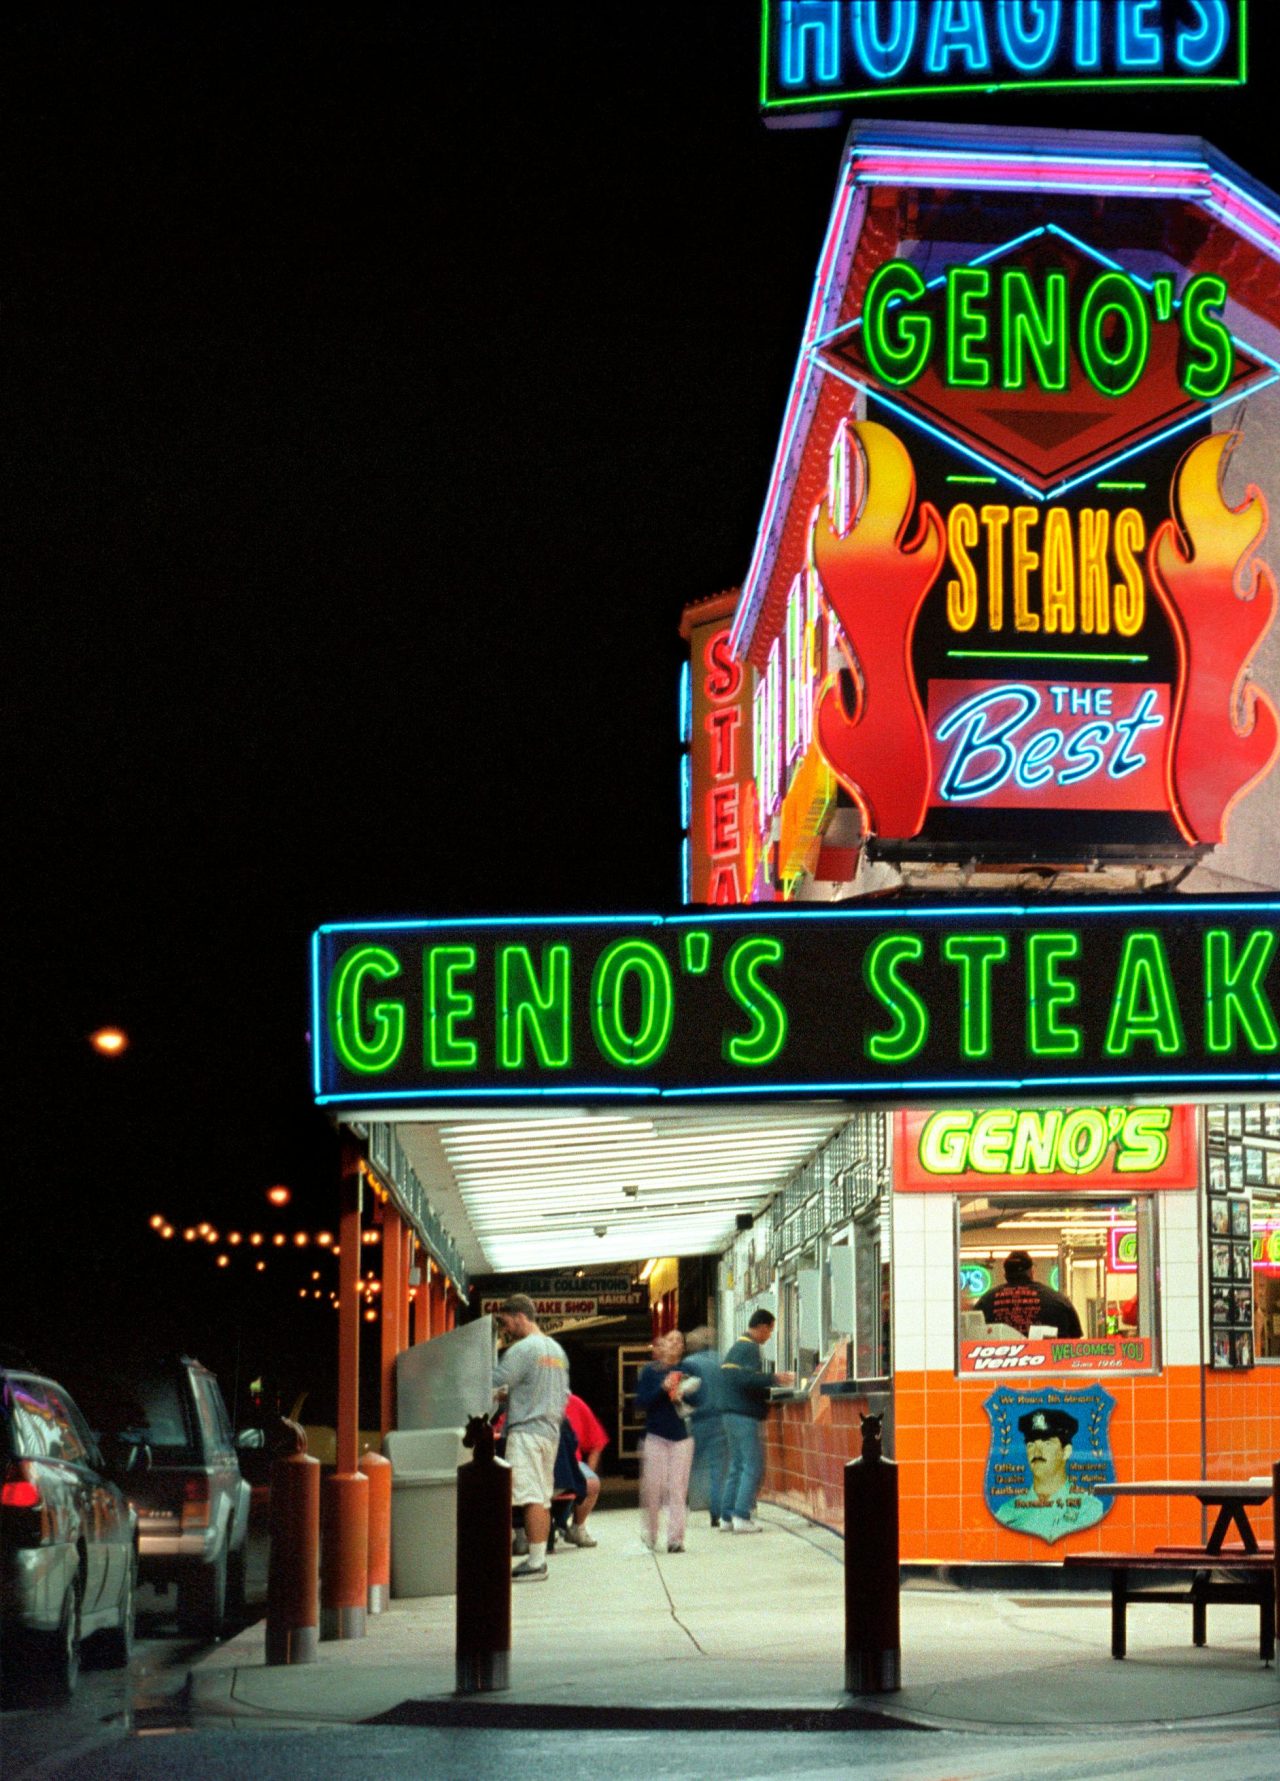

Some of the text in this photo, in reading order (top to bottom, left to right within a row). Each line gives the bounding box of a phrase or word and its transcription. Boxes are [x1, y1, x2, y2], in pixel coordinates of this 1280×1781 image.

[781, 0, 1230, 85] HOAGIES
[862, 262, 1235, 397] GENO'S
[946, 503, 1147, 637] STEAKS
[1049, 685, 1114, 717] THE
[936, 683, 1165, 801] Best
[331, 929, 791, 1074] GENO'S
[918, 1106, 1174, 1177] GENO'S
[564, 1300, 594, 1314] SHOP
[967, 1344, 1025, 1359] Joey
[1051, 1342, 1144, 1363] WELCOMES YOU
